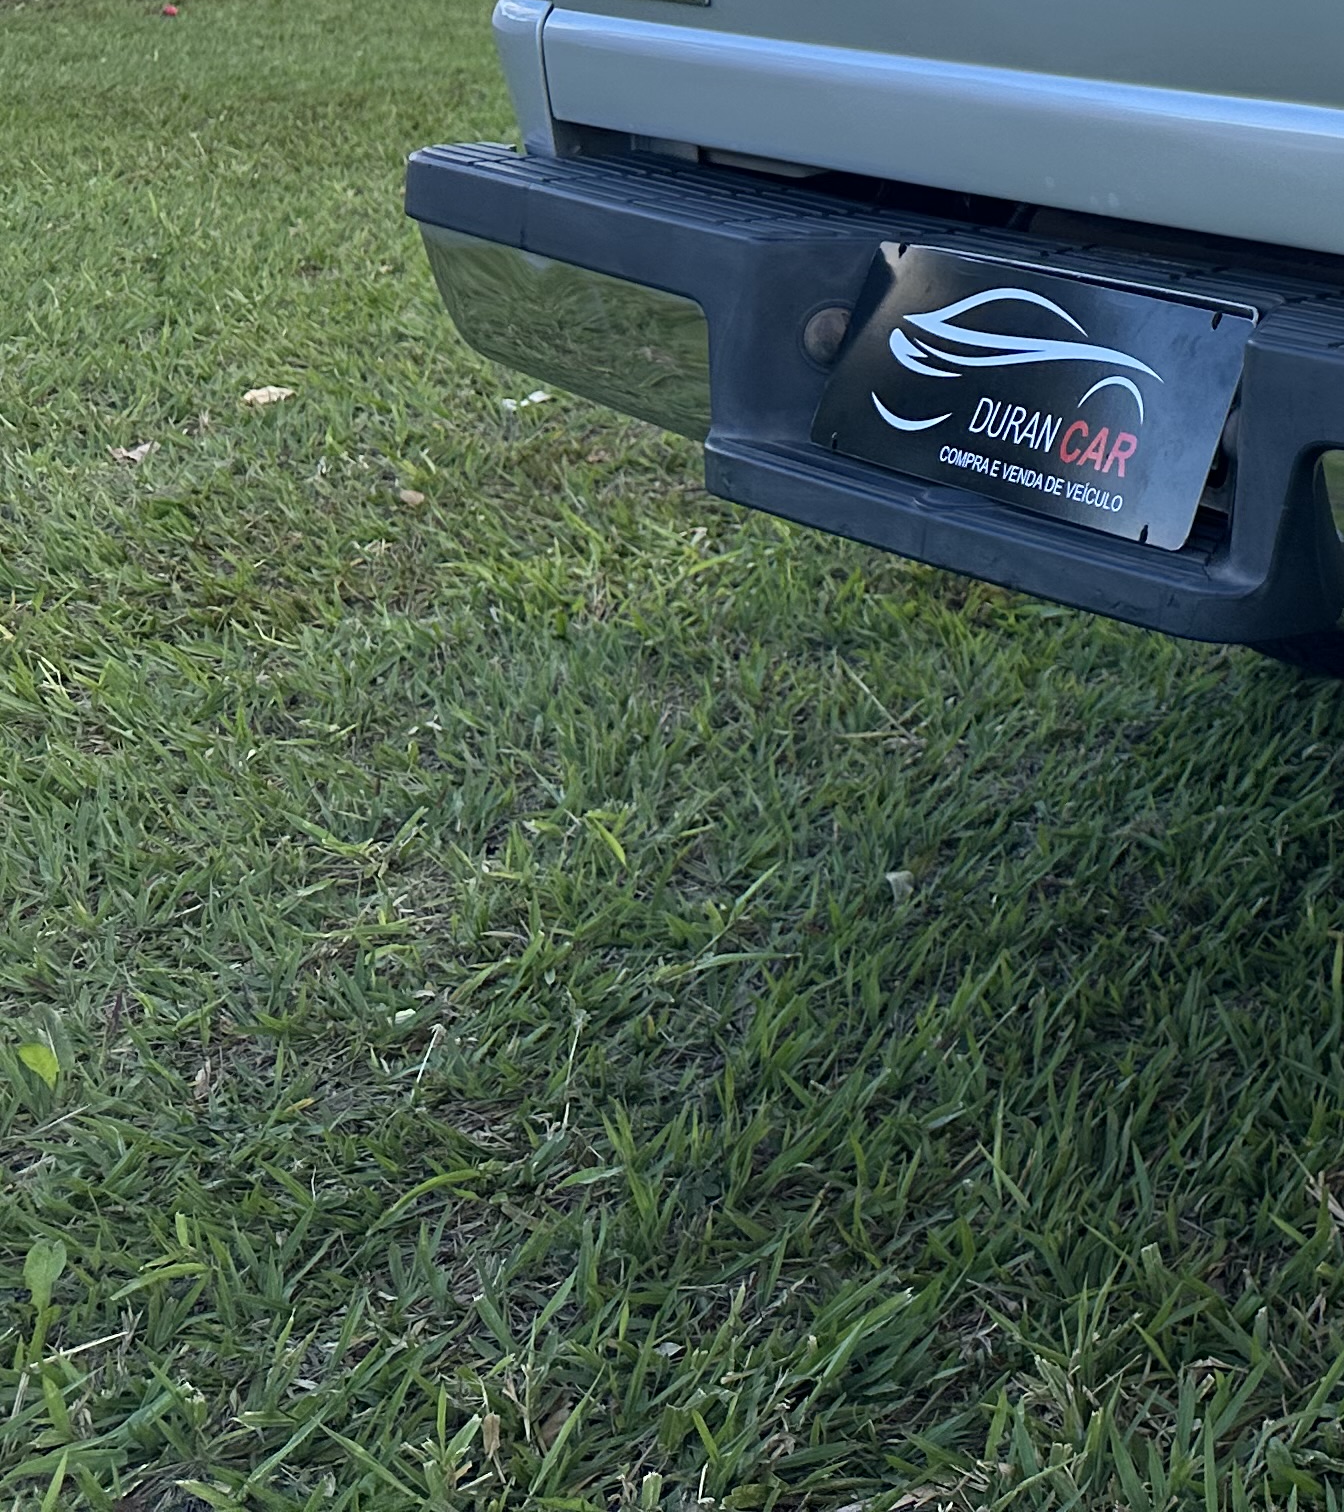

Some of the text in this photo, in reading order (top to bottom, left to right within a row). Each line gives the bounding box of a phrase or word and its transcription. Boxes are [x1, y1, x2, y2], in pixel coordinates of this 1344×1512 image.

[967, 397, 1139, 478] DURAN CAR
[938, 445, 1124, 513] COMPRA E VENDA DE VEÍCULO
